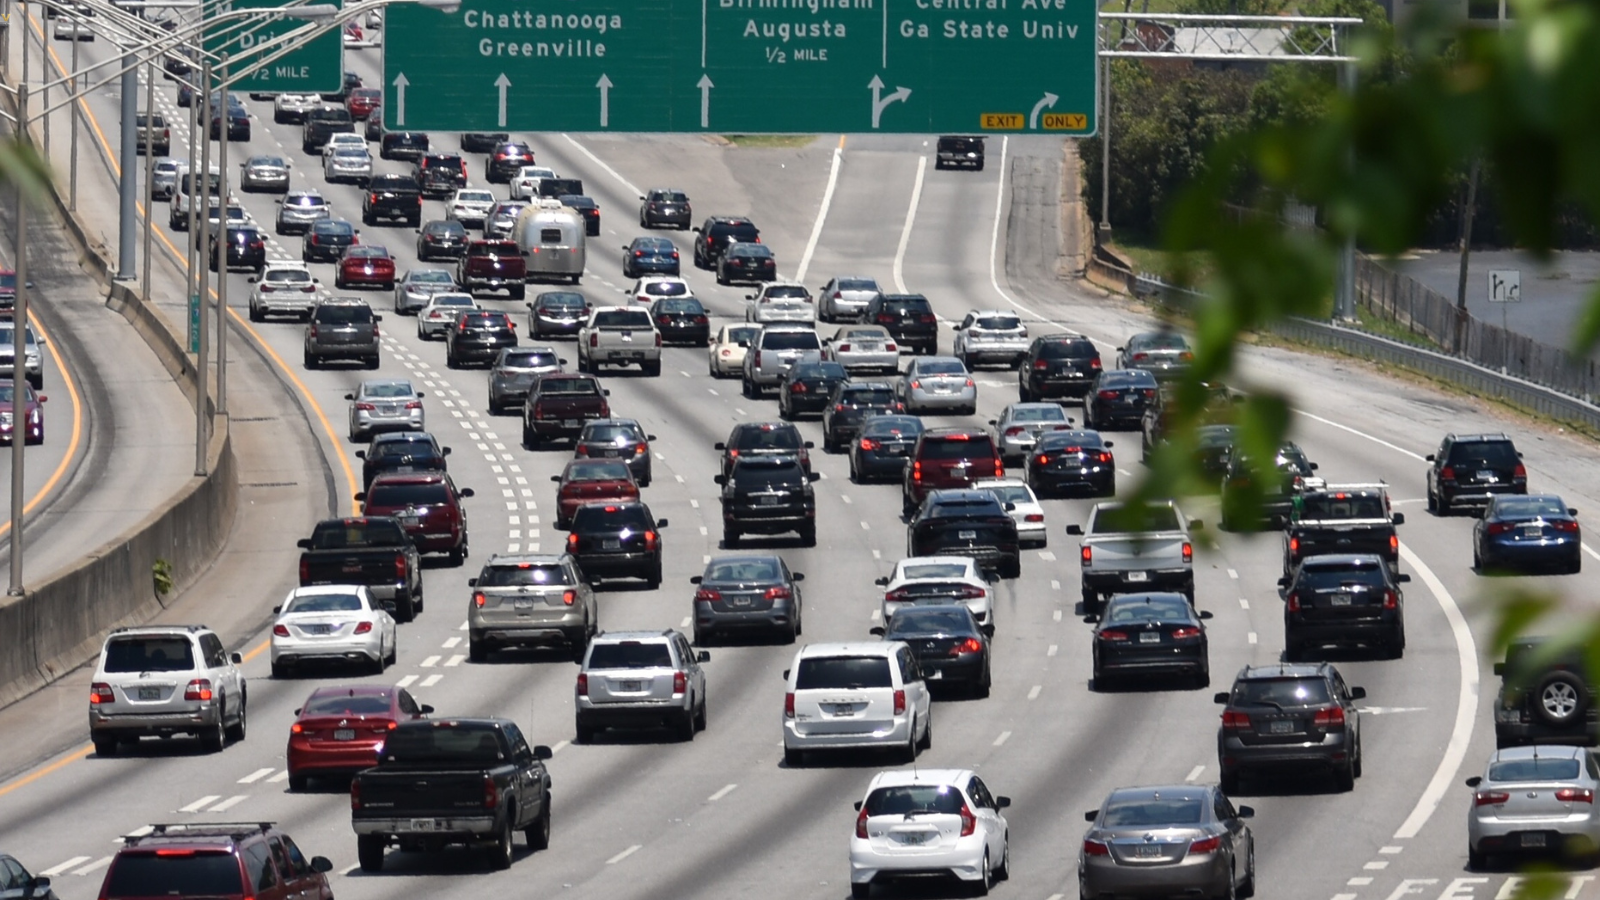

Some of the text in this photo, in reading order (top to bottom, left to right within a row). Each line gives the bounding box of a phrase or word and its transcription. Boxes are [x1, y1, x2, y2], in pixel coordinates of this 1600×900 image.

[1021, 0, 1066, 9] Ave
[464, 9, 622, 34] Chattanooga
[899, 19, 1078, 39] Ga State Univ
[743, 19, 846, 42] Augusta
[479, 38, 606, 57] Greenville
[794, 49, 828, 61] MILE
[250, 66, 310, 80] /2 MILE
[986, 115, 1084, 127] EXIT ONLY
